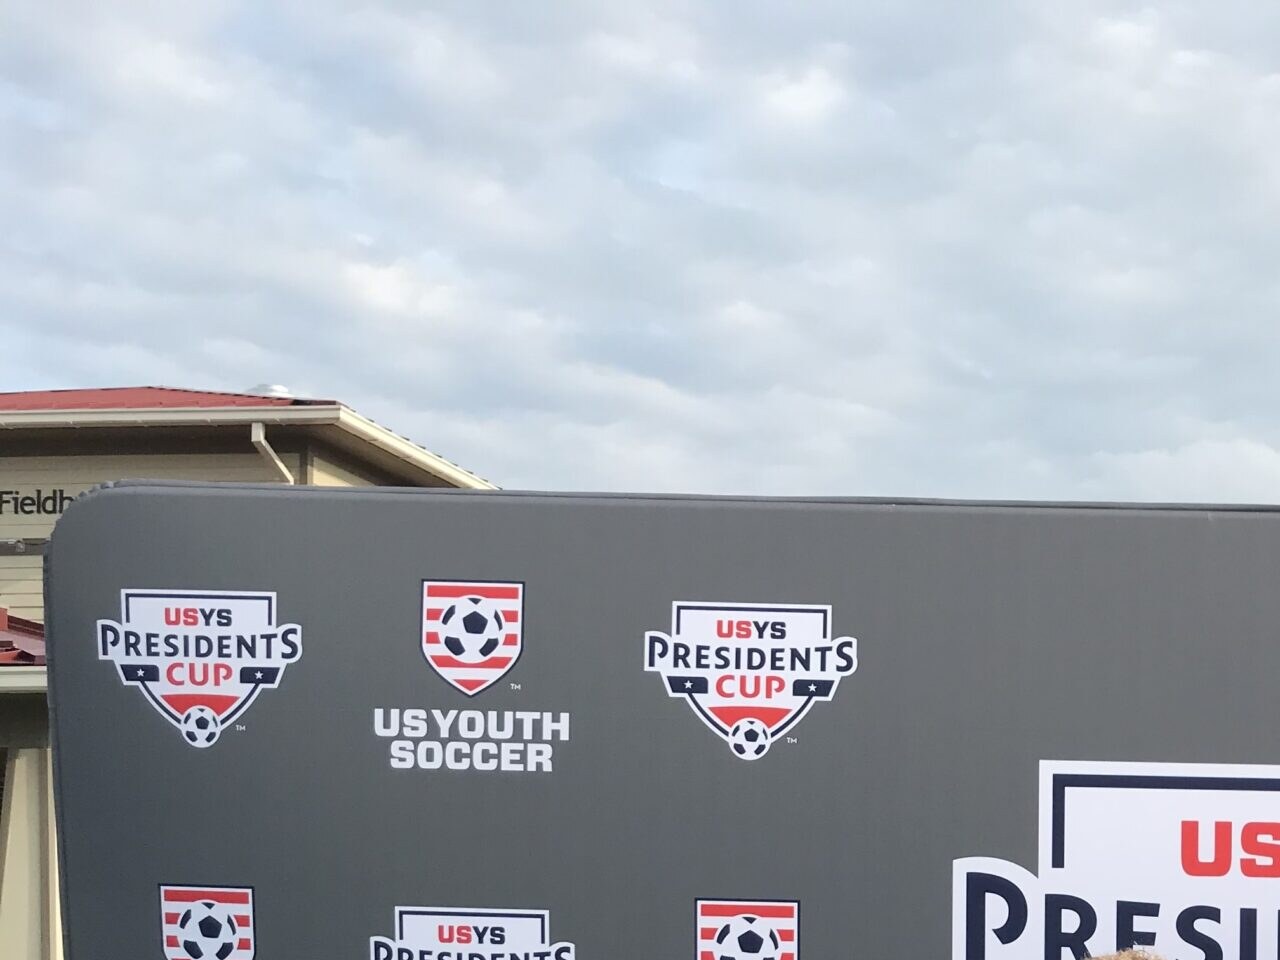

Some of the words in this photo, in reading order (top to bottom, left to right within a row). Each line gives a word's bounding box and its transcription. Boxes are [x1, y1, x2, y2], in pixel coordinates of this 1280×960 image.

[165, 608, 232, 626] USYS
[717, 620, 786, 639] USYS
[101, 624, 298, 659] PRESIDENTS
[649, 636, 853, 672] PRESIDENTS
[167, 663, 232, 686] CUP
[716, 675, 785, 698] CUP
[391, 741, 552, 771] SOCCER
[439, 926, 505, 944] USYS
